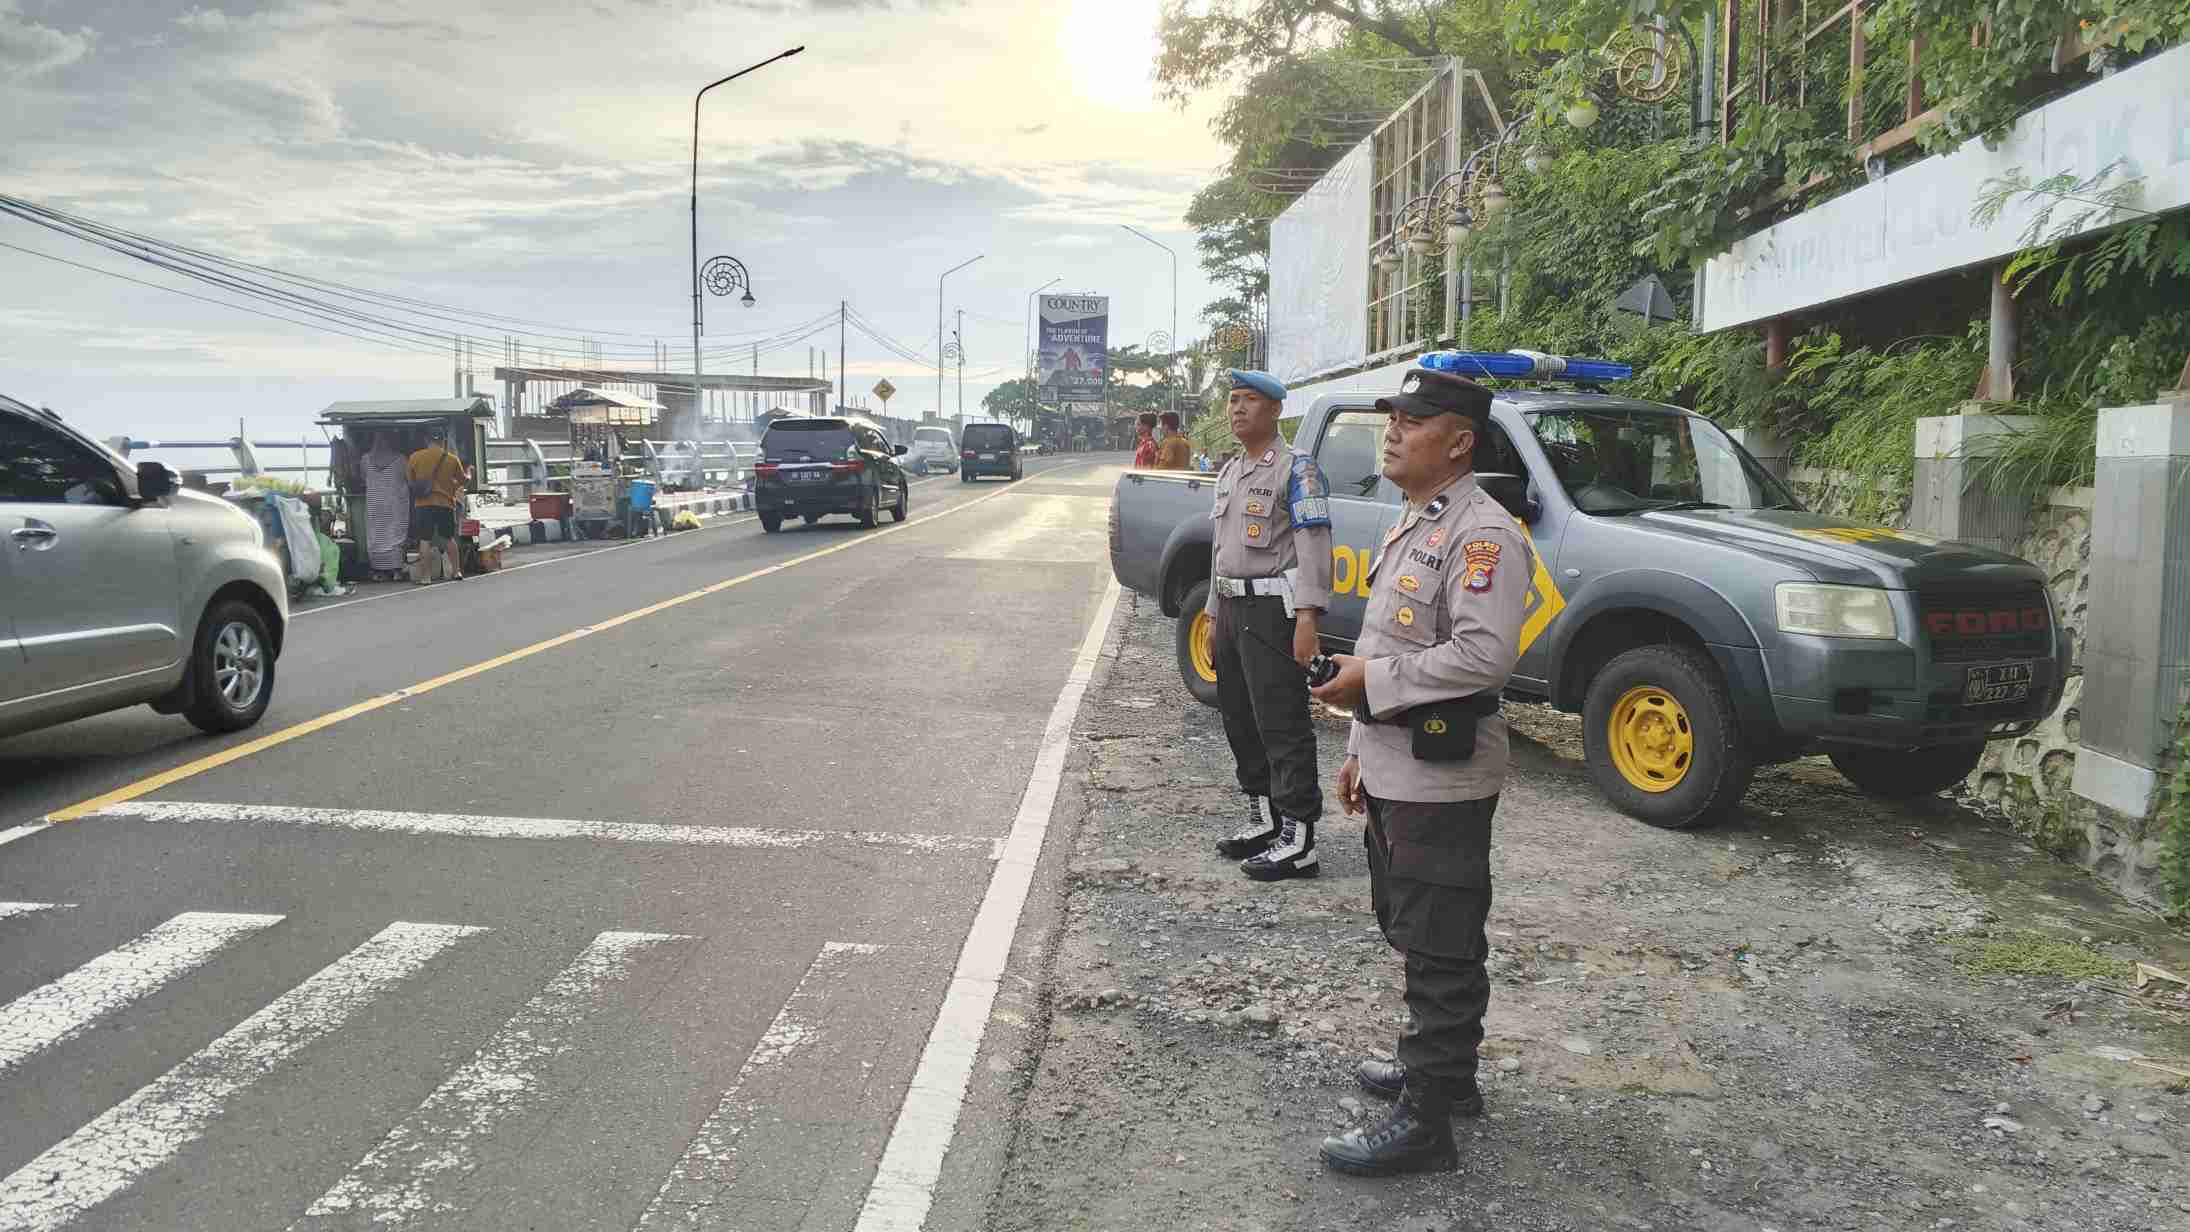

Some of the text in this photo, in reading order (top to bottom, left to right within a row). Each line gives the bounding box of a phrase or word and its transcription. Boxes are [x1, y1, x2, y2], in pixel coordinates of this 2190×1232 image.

[1048, 298, 1100, 313] COUNTRY
[1248, 487, 1273, 497] POLRI
[1408, 548, 1443, 571] POLRI
